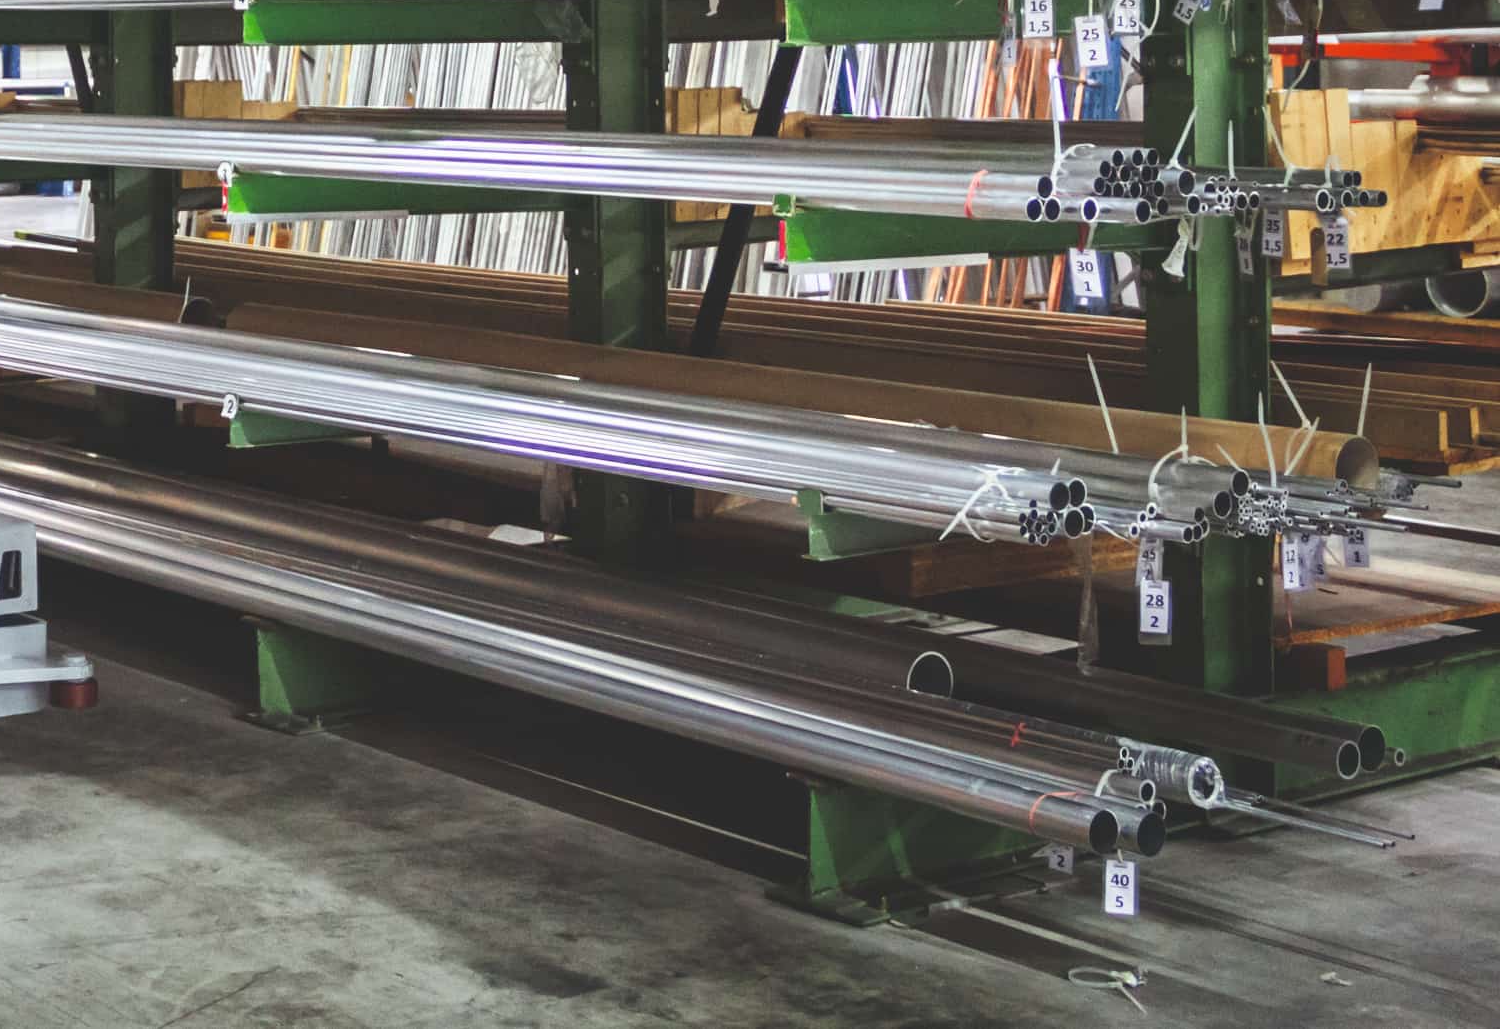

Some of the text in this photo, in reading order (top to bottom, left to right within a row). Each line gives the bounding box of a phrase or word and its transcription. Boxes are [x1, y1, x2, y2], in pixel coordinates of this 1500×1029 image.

[1030, 0, 1048, 12] 16
[1029, 21, 1050, 35] 1,5
[1116, 16, 1137, 28] 1,5
[1081, 29, 1100, 41] 25
[1089, 49, 1098, 61] 2
[1267, 219, 1280, 231] 35
[1265, 239, 1281, 253] 1,5
[1326, 233, 1344, 246] 22
[1076, 260, 1094, 272] 30
[1326, 253, 1347, 266] 1,5
[1084, 281, 1092, 292] 1
[227, 399, 234, 414] 2
[1145, 594, 1164, 607] 28
[1150, 615, 1160, 628] 2
[1110, 874, 1130, 887] 40
[1115, 896, 1124, 909] 5
